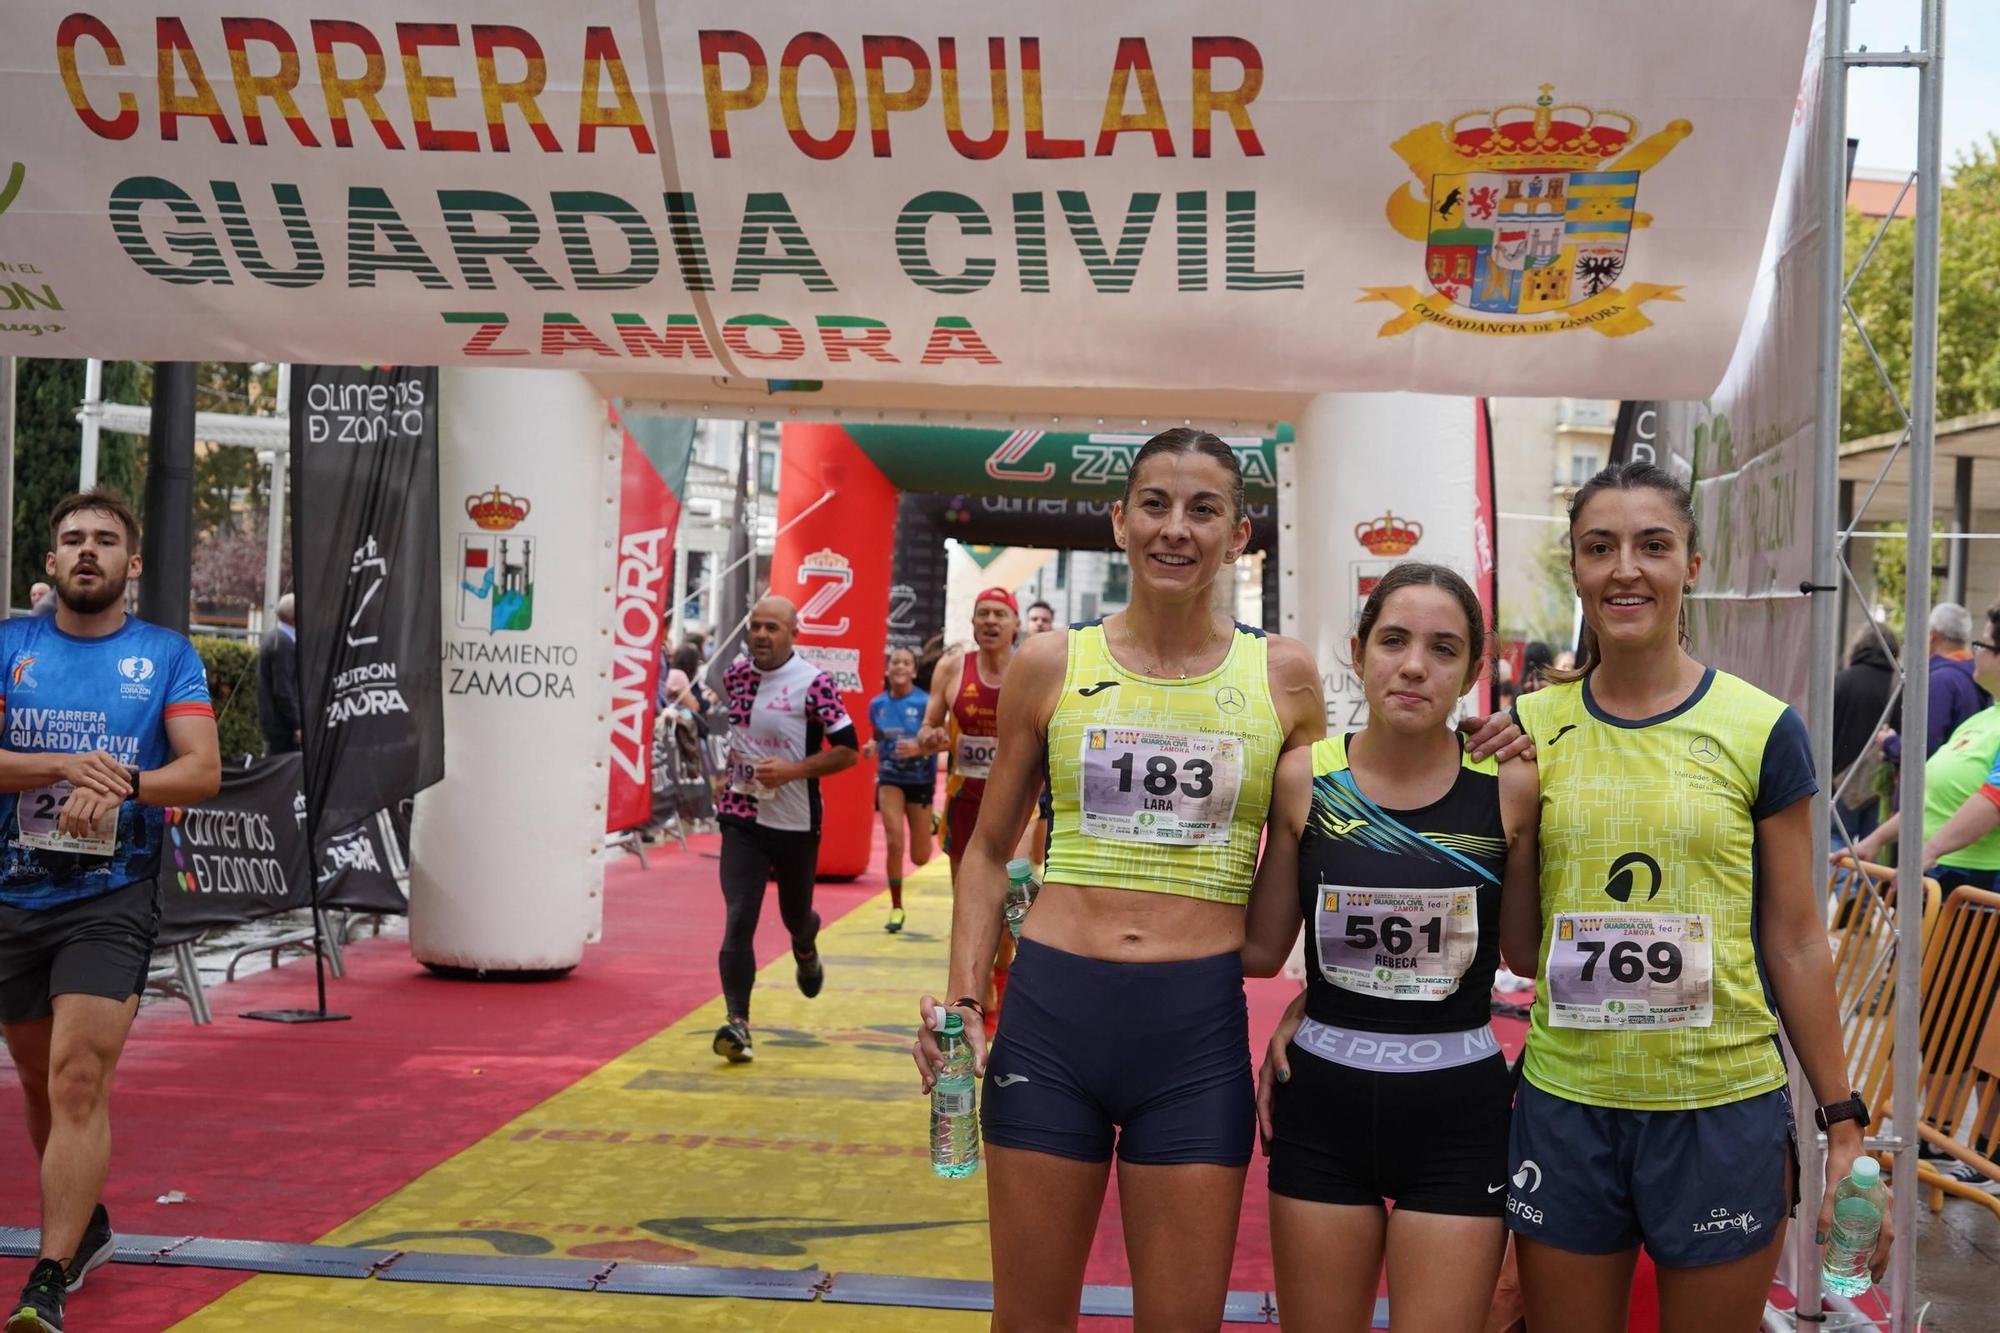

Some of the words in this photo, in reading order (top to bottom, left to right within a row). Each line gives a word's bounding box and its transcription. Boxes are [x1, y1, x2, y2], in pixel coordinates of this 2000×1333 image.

[56, 12, 656, 153] CARRERA
[698, 30, 1266, 161] POPULAR
[108, 176, 839, 292] GUARDIA
[894, 190, 1304, 295] CIVIL
[19, 264, 42, 274] EL
[1412, 303, 1527, 334] COMANDANCIA
[1533, 323, 1554, 333] DE
[1559, 304, 1627, 330] ZAMORA
[440, 312, 1003, 365] ZAMORA
[607, 527, 668, 785] ZAMORA
[448, 668, 576, 699] ZAMORA
[10, 708, 49, 731] XIV
[48, 709, 107, 723] CARRERA
[48, 720, 106, 734] POPULAR
[10, 730, 92, 751] GUARDIA
[96, 734, 140, 753] CIVIL
[1112, 752, 1214, 799] 183
[1143, 798, 1174, 811] LARA
[184, 808, 276, 852] alimentos
[210, 855, 289, 895] zamora
[1344, 915, 1442, 955] 561
[1375, 954, 1417, 969] REBECA
[1576, 941, 1683, 984] 769
[1345, 1036, 1443, 1065] PRO
[1710, 1207, 1730, 1218] C.D.
